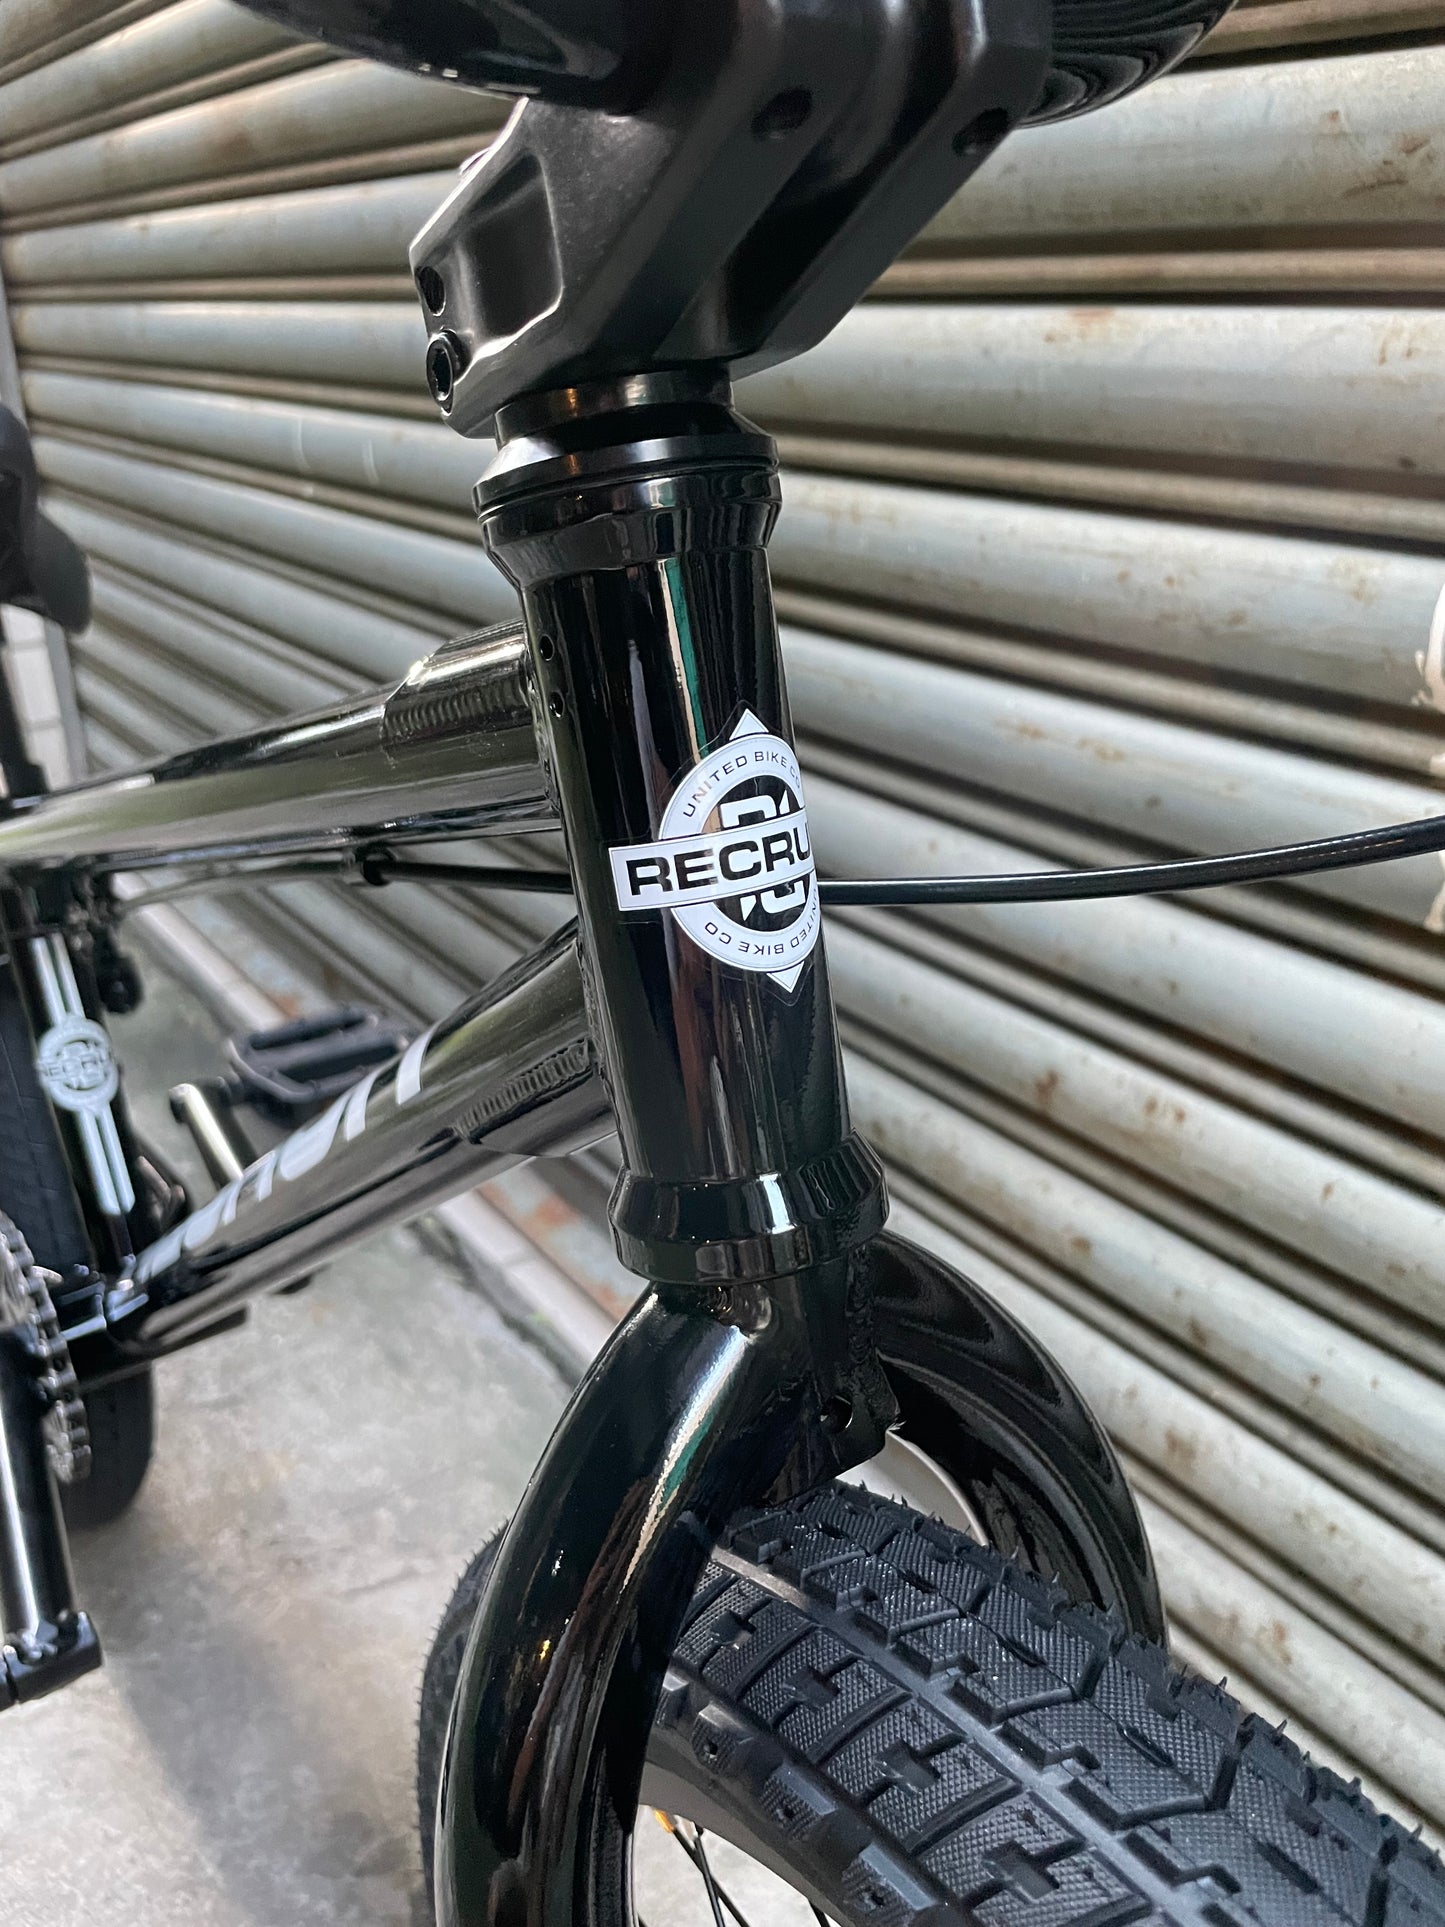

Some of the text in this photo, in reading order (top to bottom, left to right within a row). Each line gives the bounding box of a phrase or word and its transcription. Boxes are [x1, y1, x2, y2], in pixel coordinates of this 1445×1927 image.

[683, 755, 747, 818] UNITED
[754, 751, 787, 768] BIKE
[705, 922, 732, 944] CO
[738, 941, 785, 955] BIKE
